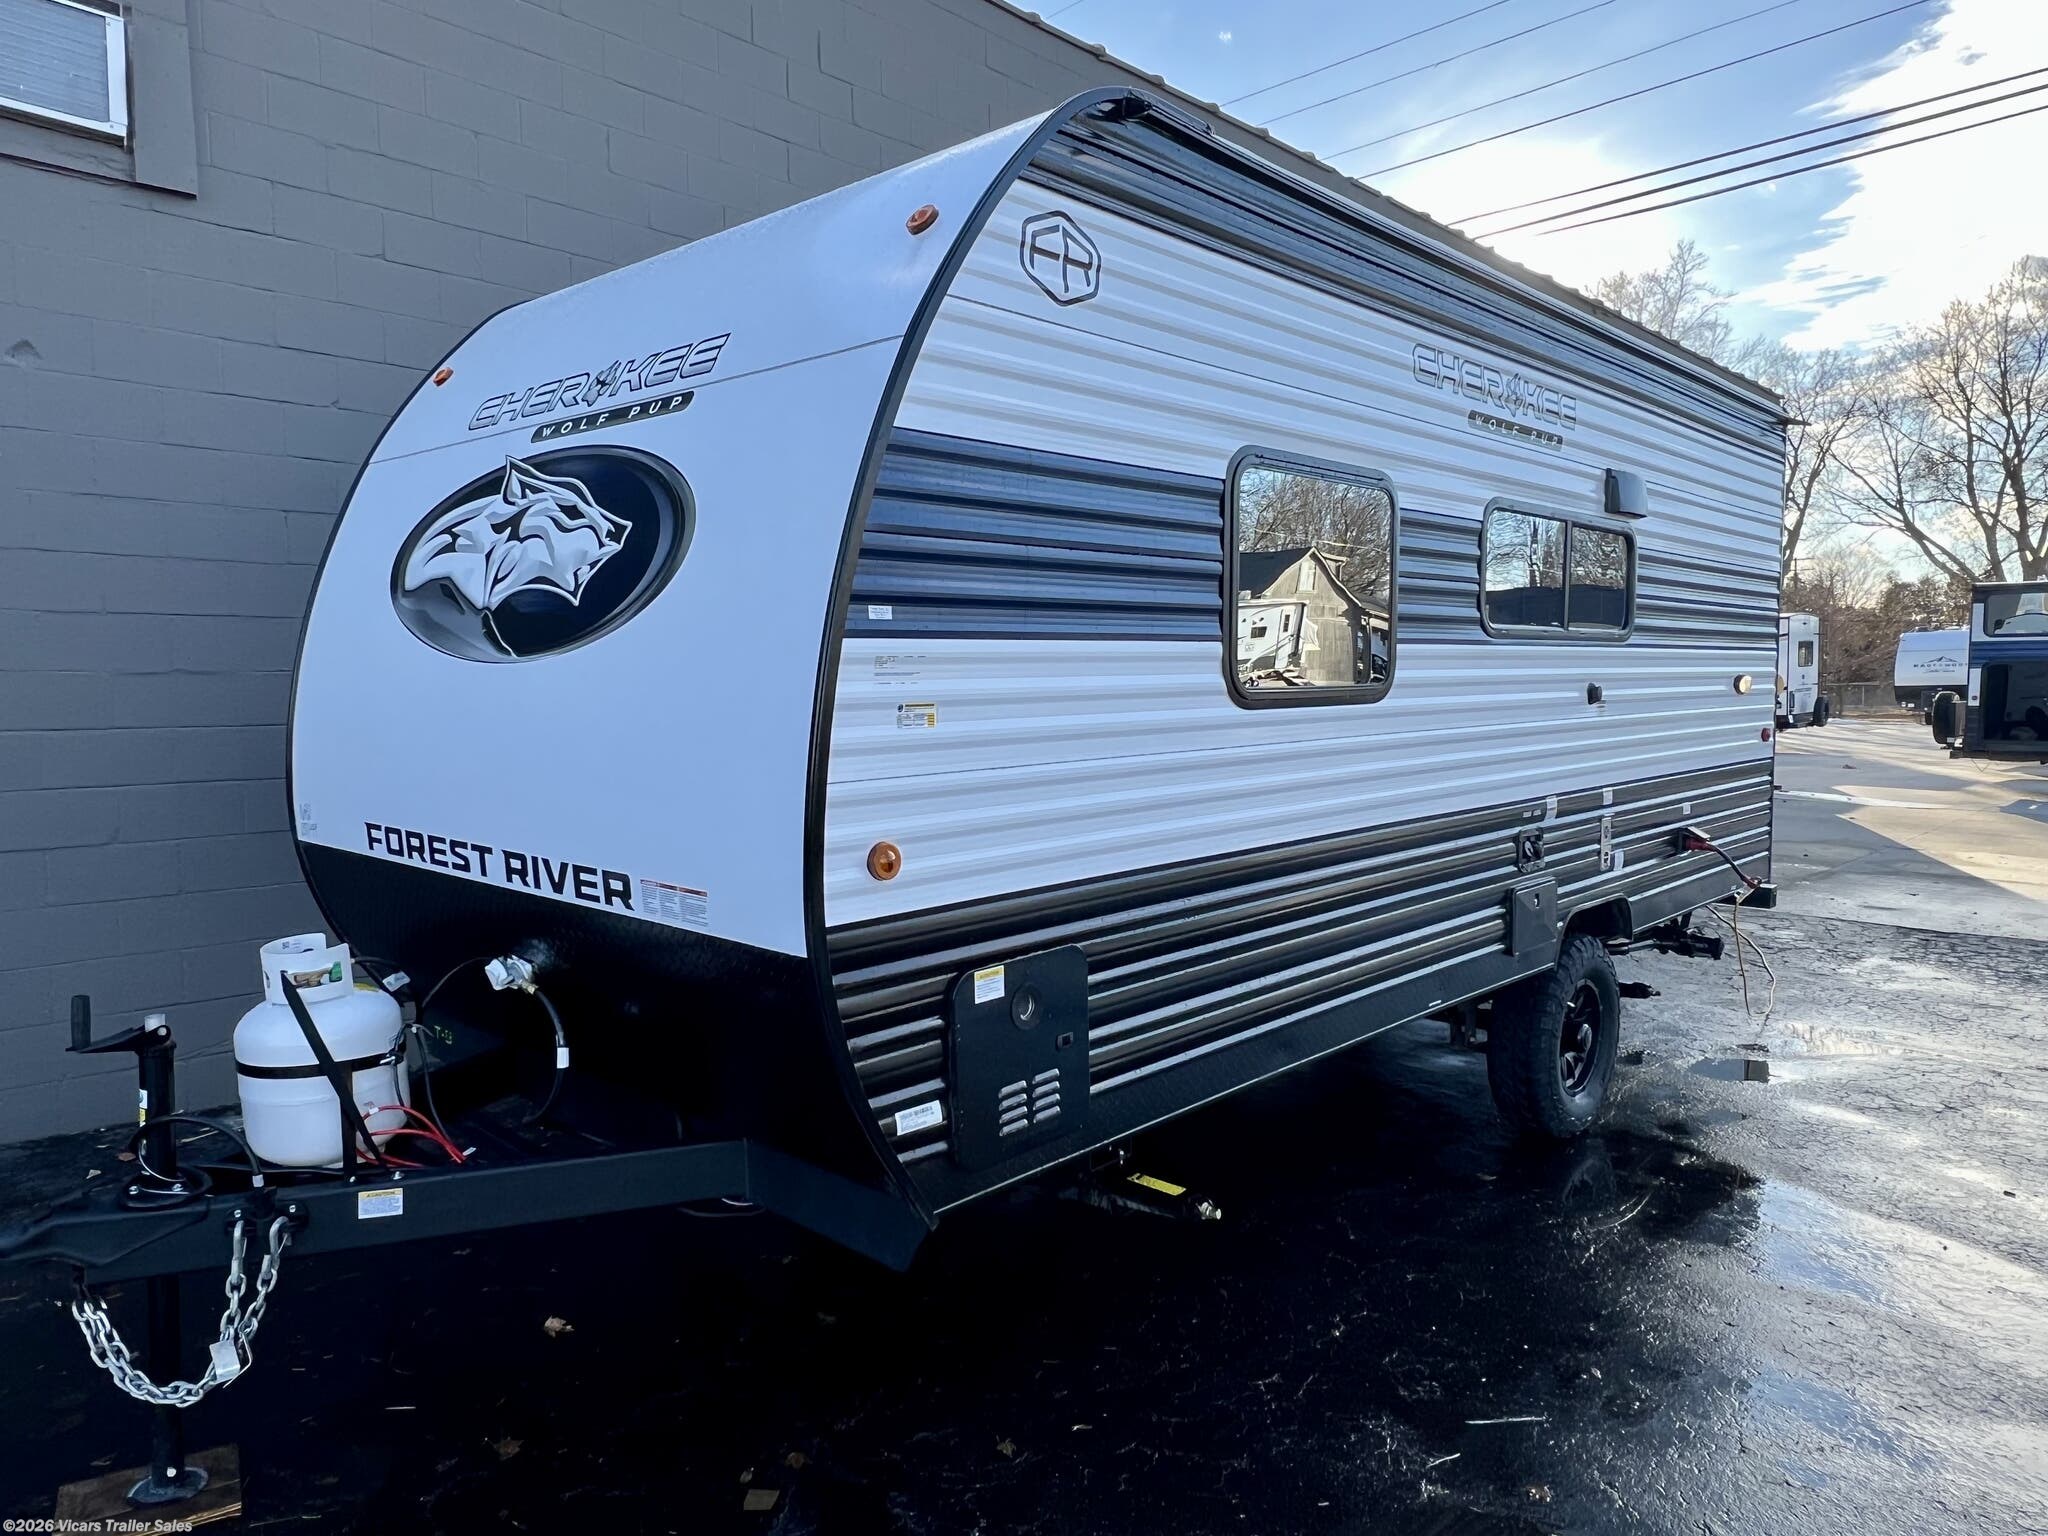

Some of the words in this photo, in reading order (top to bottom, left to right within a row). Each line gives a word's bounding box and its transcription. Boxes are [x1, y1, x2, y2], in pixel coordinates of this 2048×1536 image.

[542, 412, 610, 437] WOLF
[627, 396, 683, 420] PUP
[1475, 414, 1520, 435] WOLF
[1530, 430, 1558, 446] PUP
[364, 821, 493, 877] FOREST
[501, 848, 635, 911] RIVER
